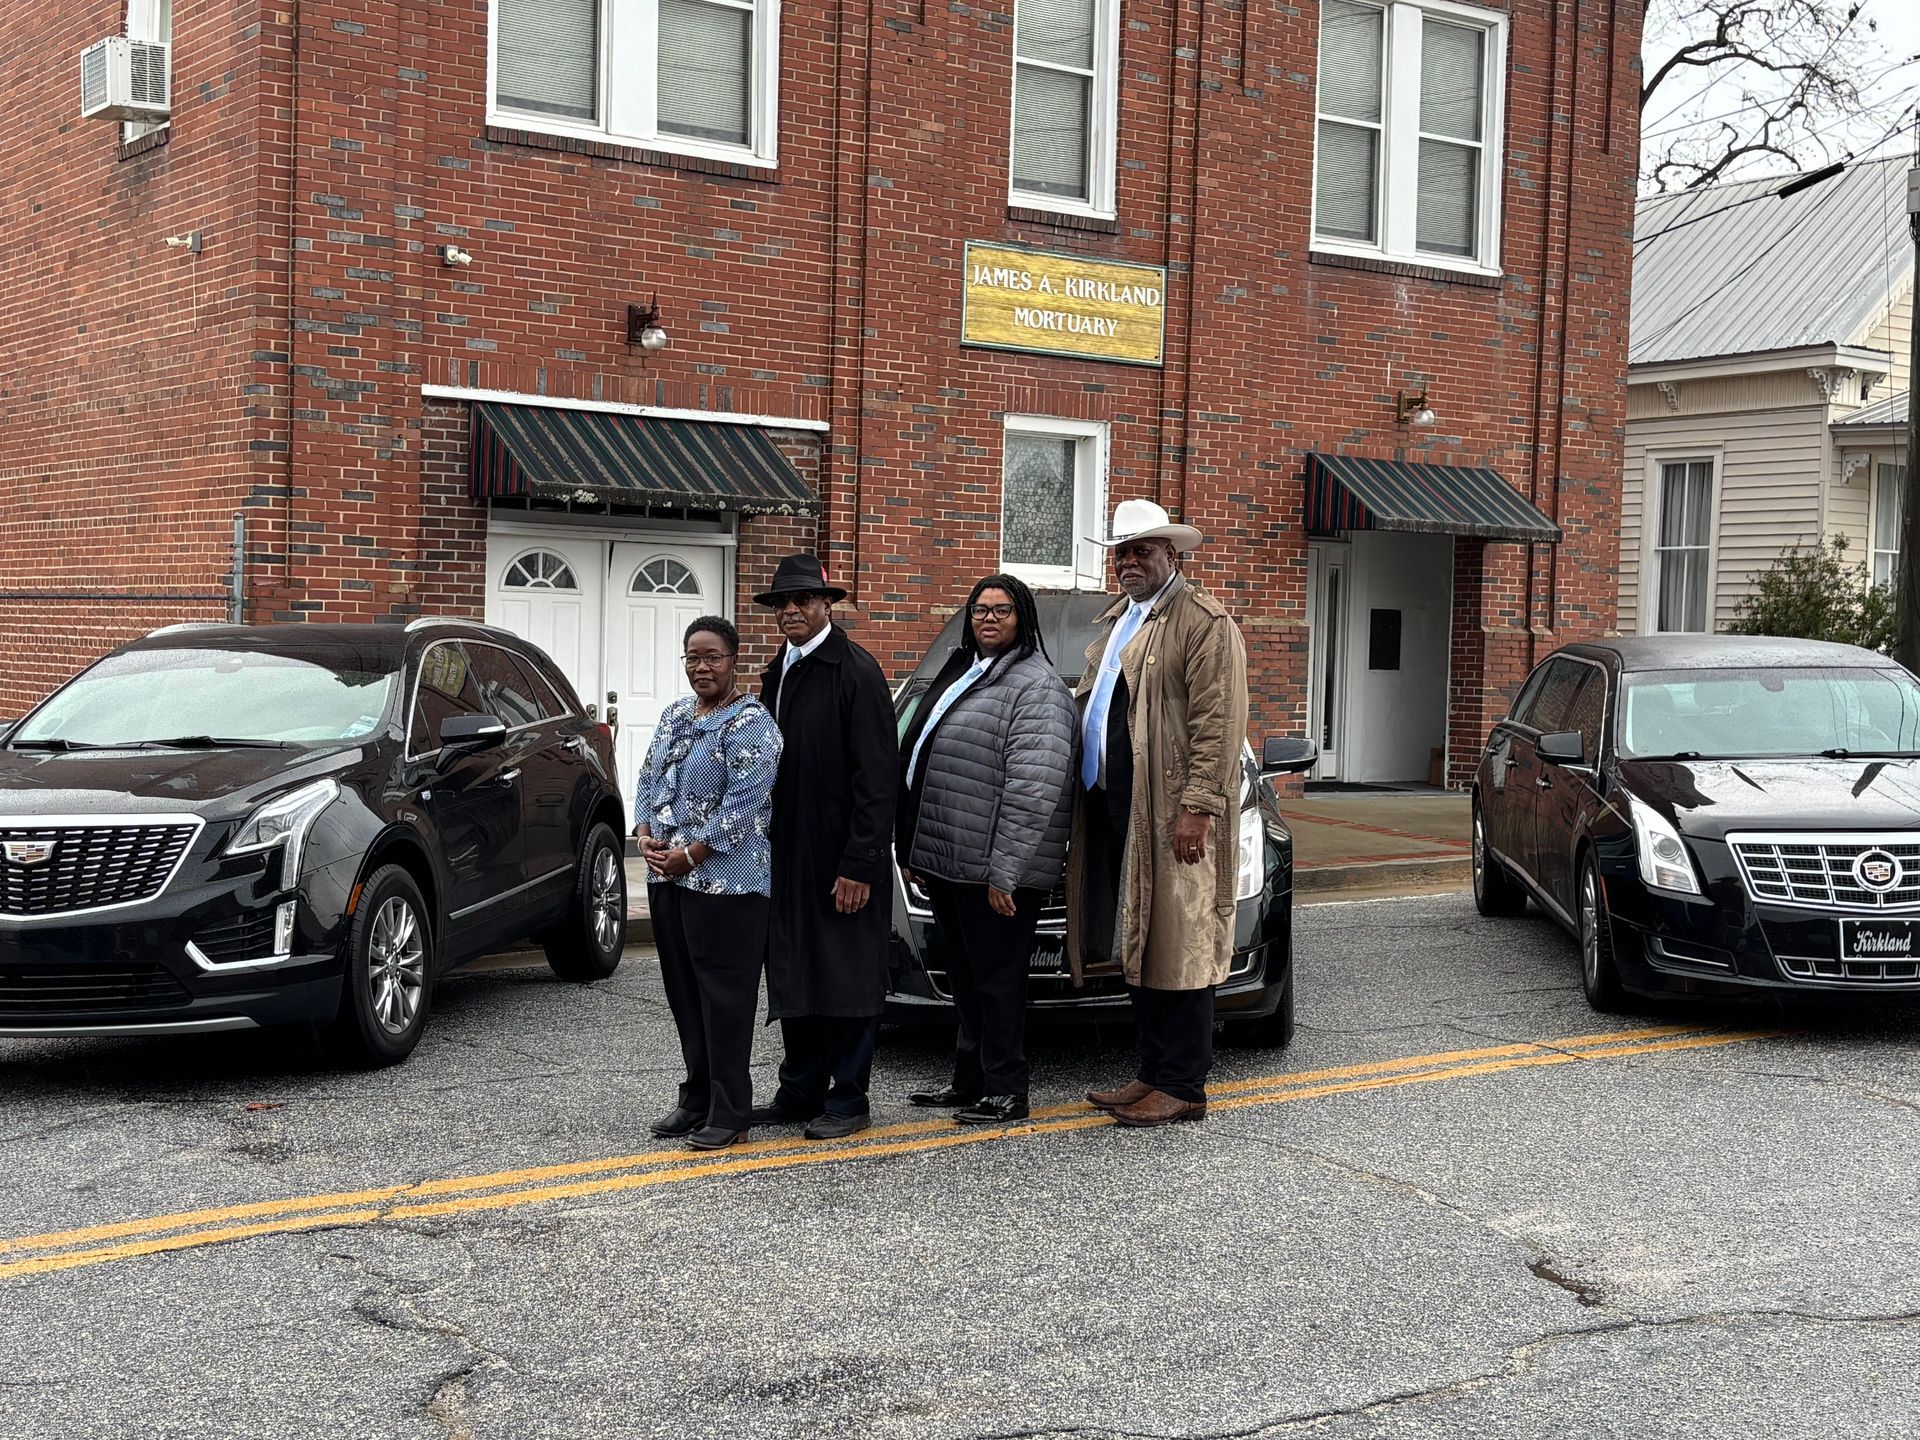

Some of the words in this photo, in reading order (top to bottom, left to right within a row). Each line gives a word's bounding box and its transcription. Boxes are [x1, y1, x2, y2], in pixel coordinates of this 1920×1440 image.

[973, 264, 1032, 292] JAMES
[1038, 274, 1058, 294] A.
[1065, 276, 1160, 306] KIRKLAND
[1014, 307, 1118, 337] MORTUARY
[1854, 930, 1911, 952] Kirkland
